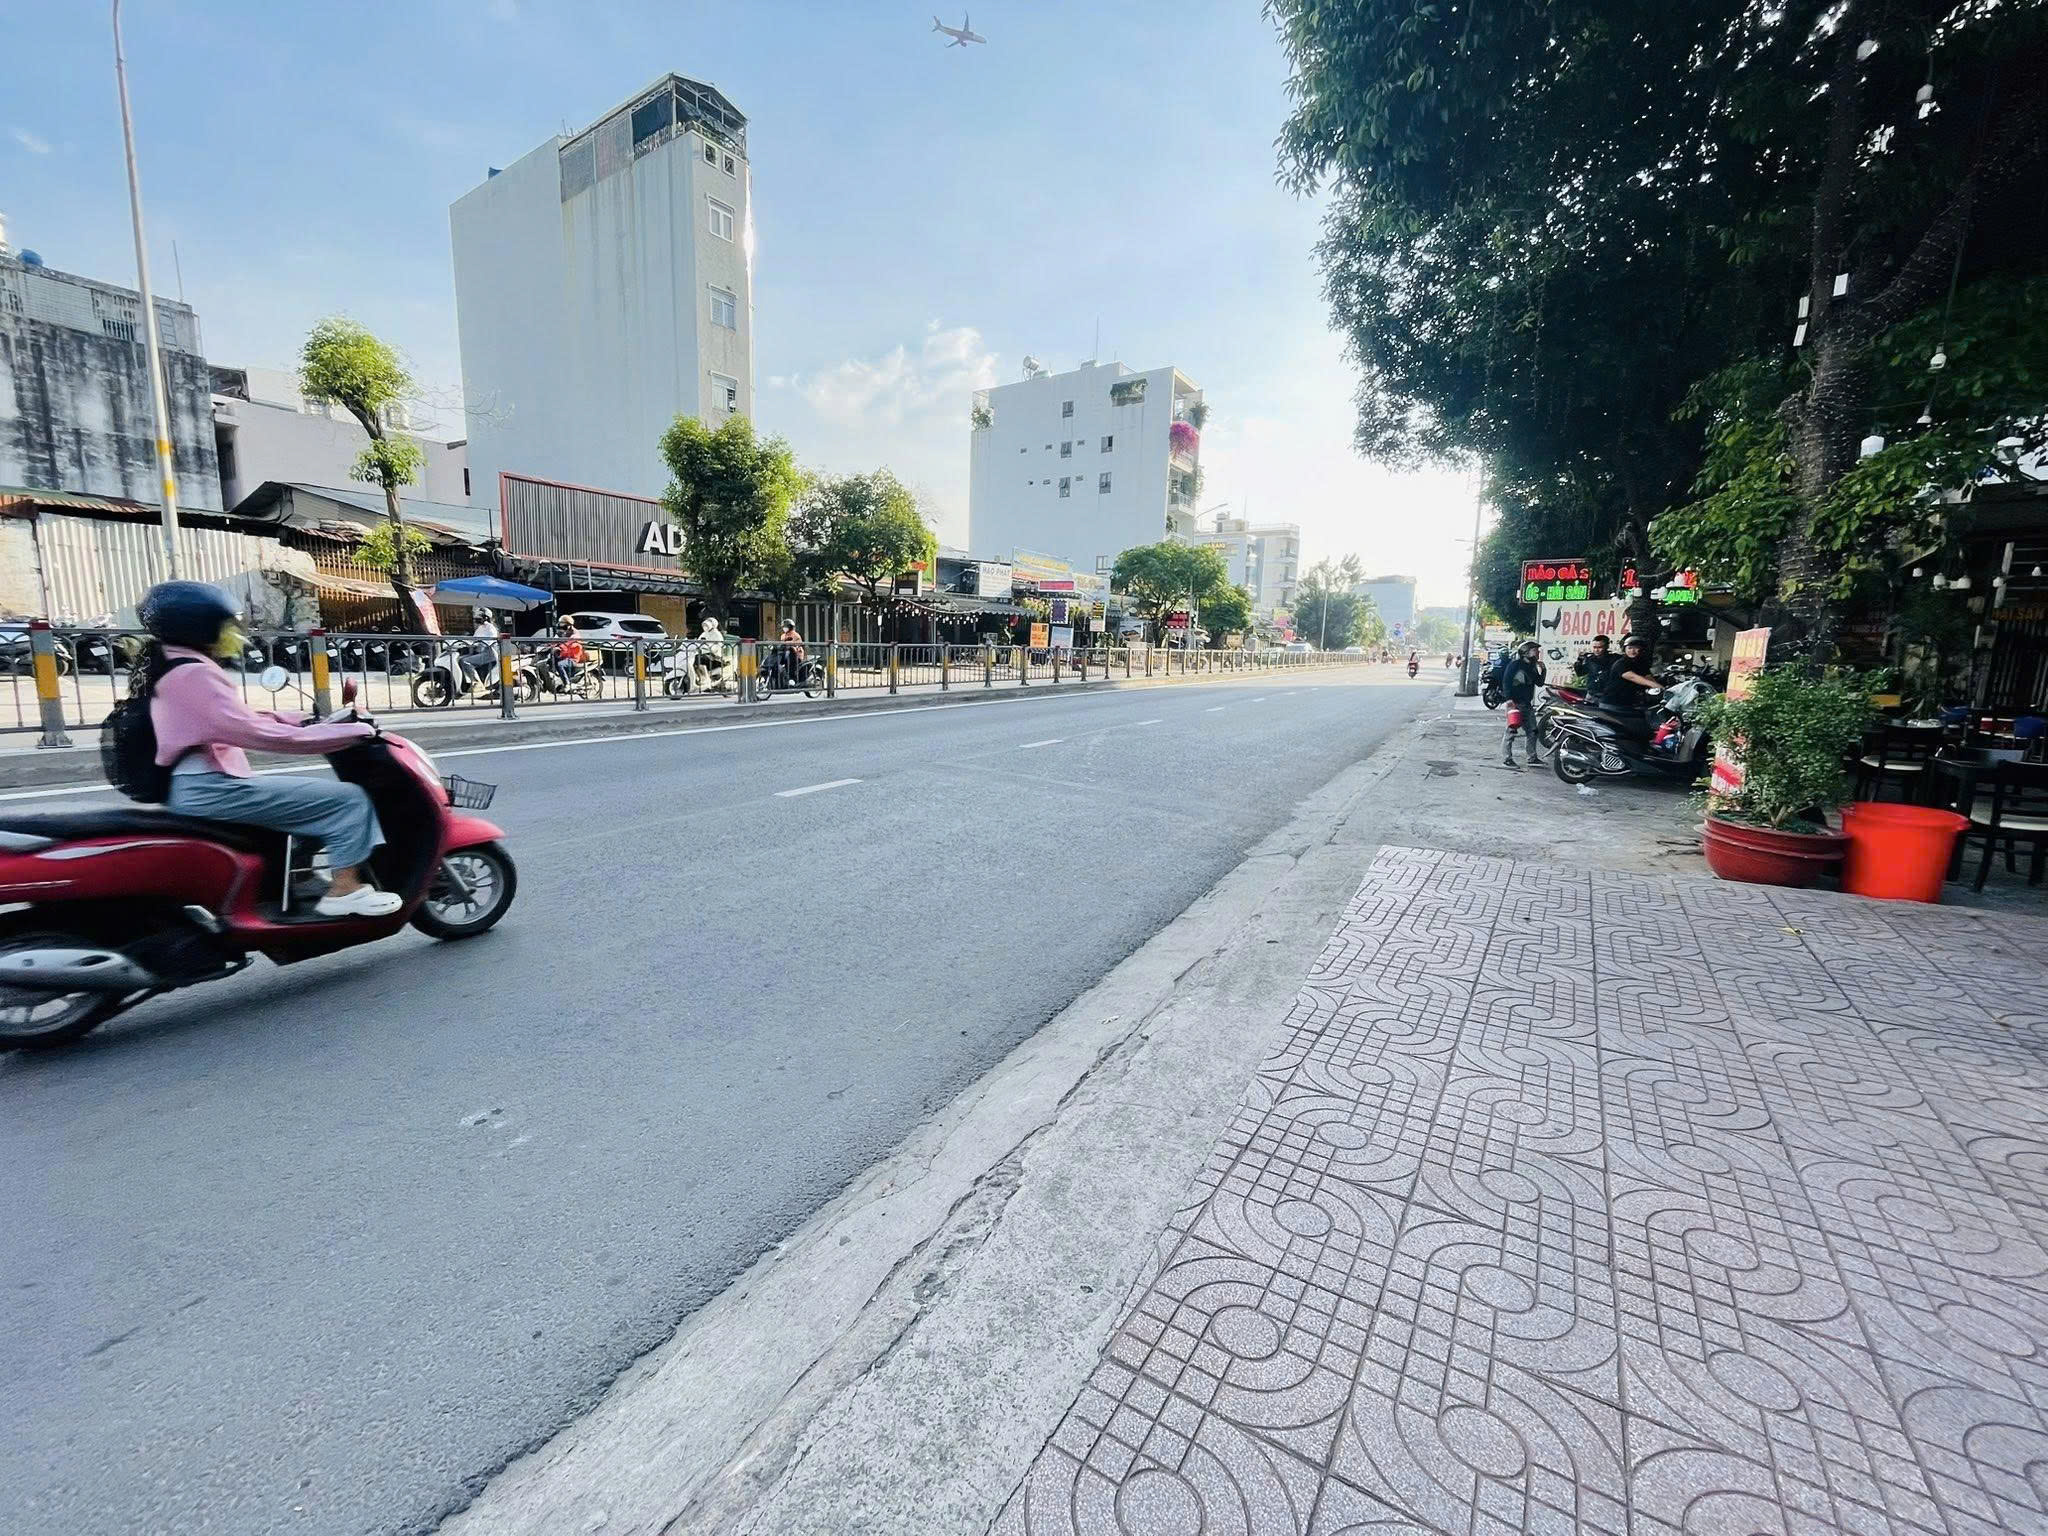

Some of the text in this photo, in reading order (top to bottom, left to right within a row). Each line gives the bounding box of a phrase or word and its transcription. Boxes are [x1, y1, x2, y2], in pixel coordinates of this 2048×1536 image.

[1561, 603, 1633, 636] BẢO GÀ 2
